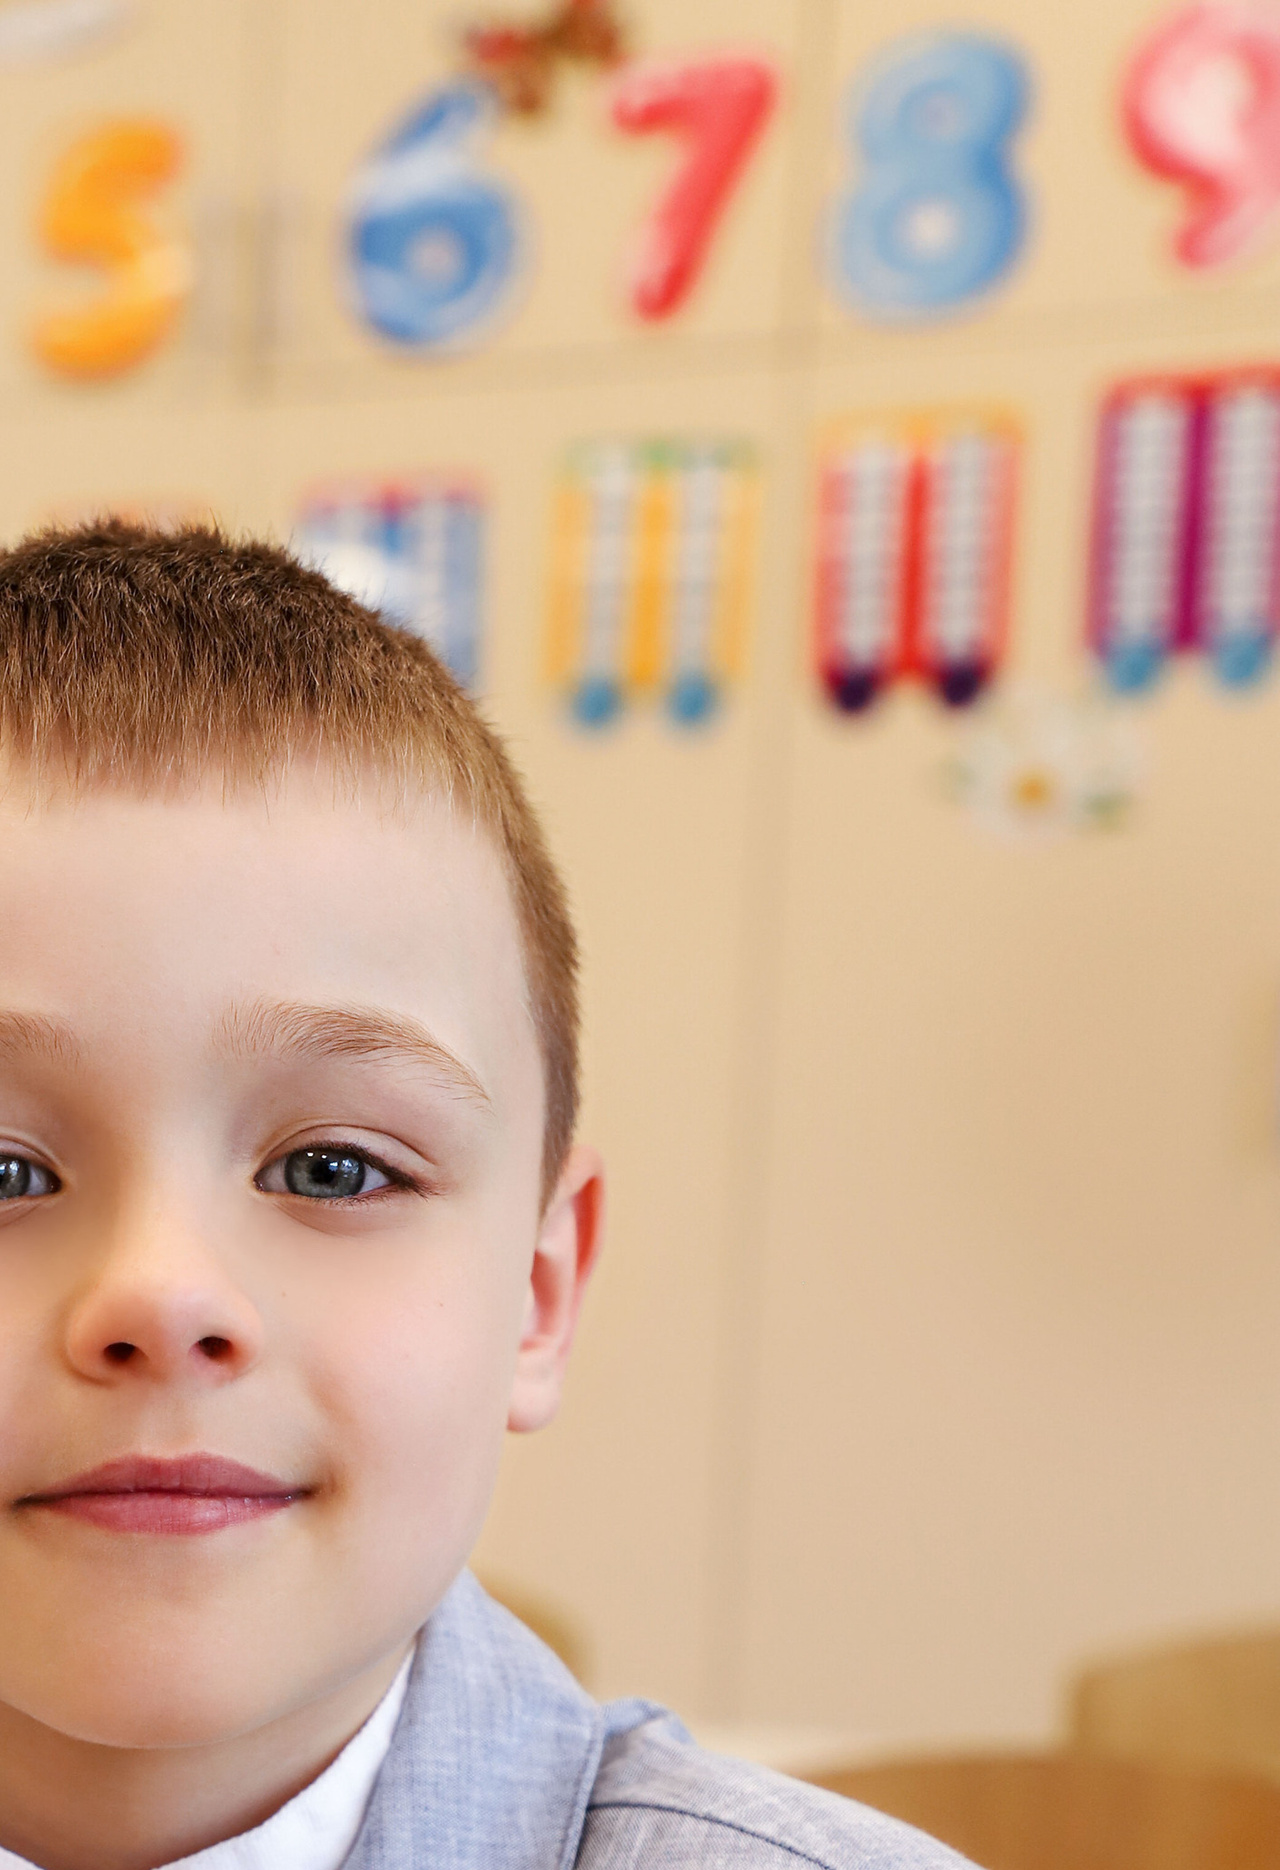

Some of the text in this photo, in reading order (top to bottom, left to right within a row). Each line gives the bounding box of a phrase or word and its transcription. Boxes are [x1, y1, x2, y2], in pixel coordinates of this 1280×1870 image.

[31, 117, 188, 384] 5
[346, 86, 518, 354] 6
[613, 48, 777, 322] 7
[832, 28, 1032, 328] 8
